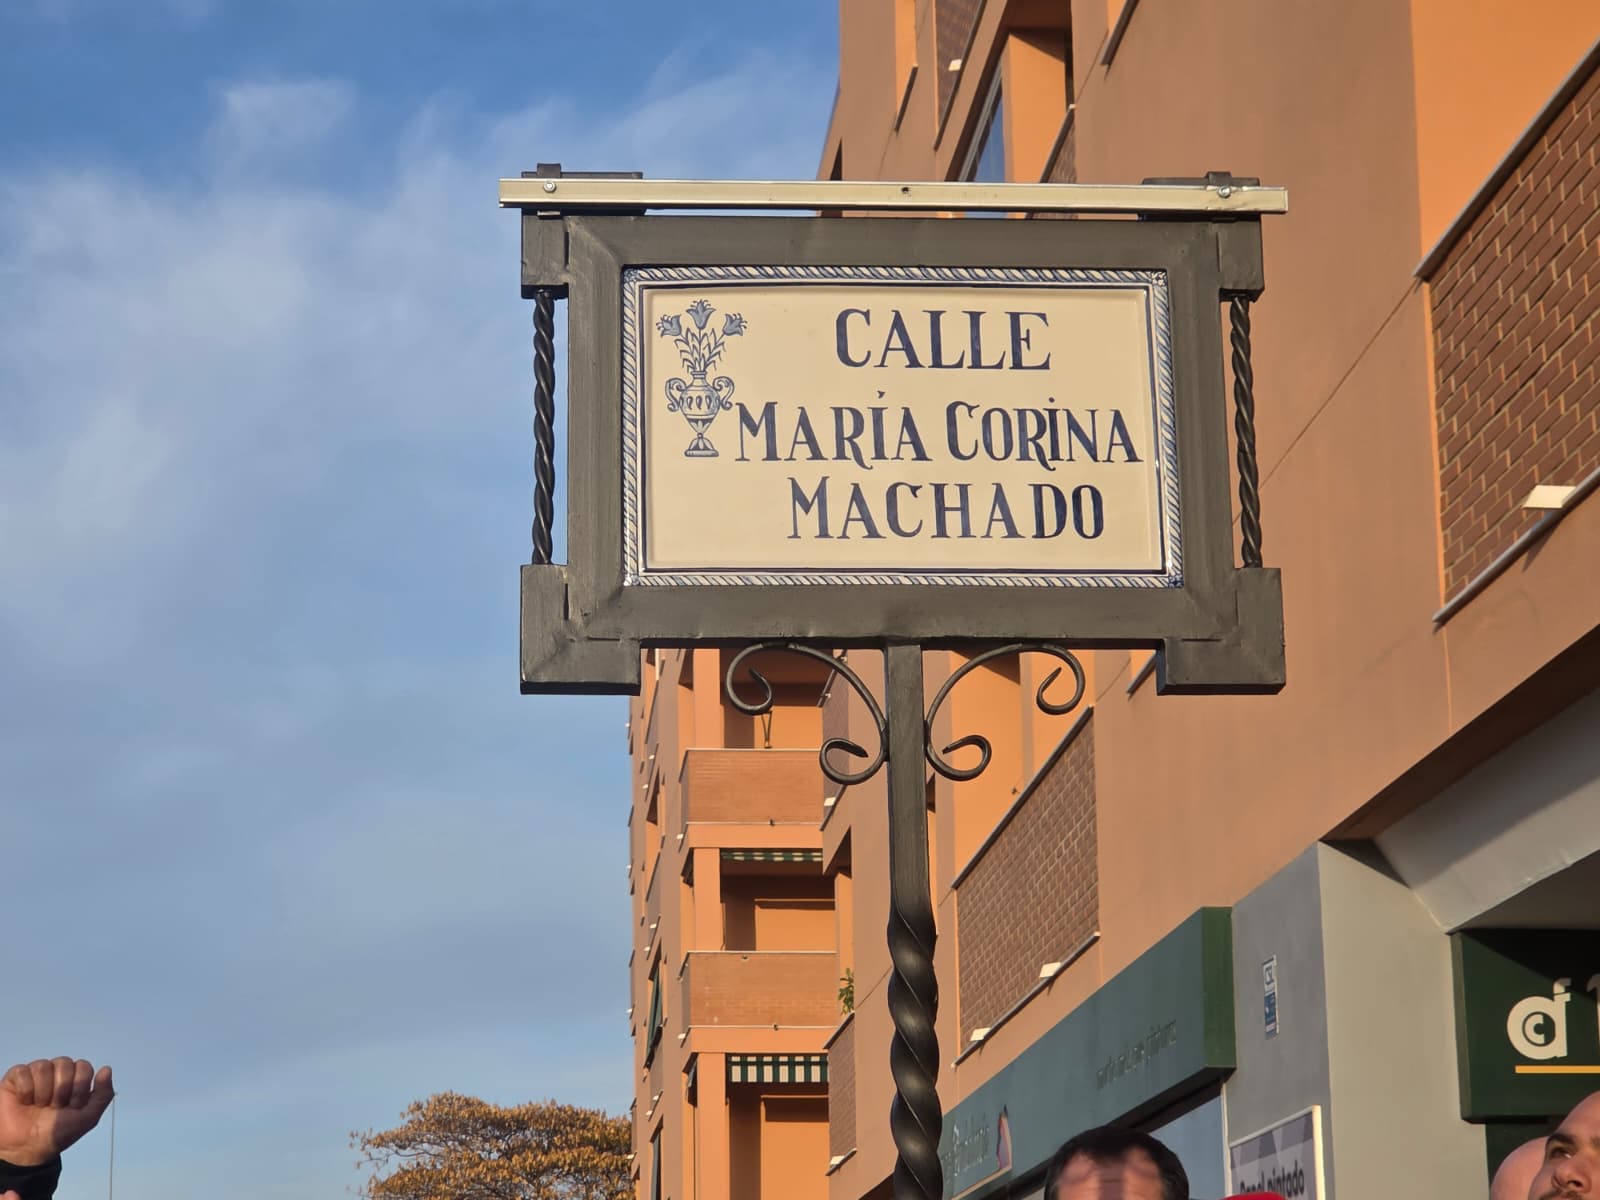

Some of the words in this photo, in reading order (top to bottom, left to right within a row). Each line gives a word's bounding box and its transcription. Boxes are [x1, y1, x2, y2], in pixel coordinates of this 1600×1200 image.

[835, 308, 1051, 371] CALLE
[734, 390, 933, 470] MARÍA
[787, 475, 1104, 539] MACHADO
